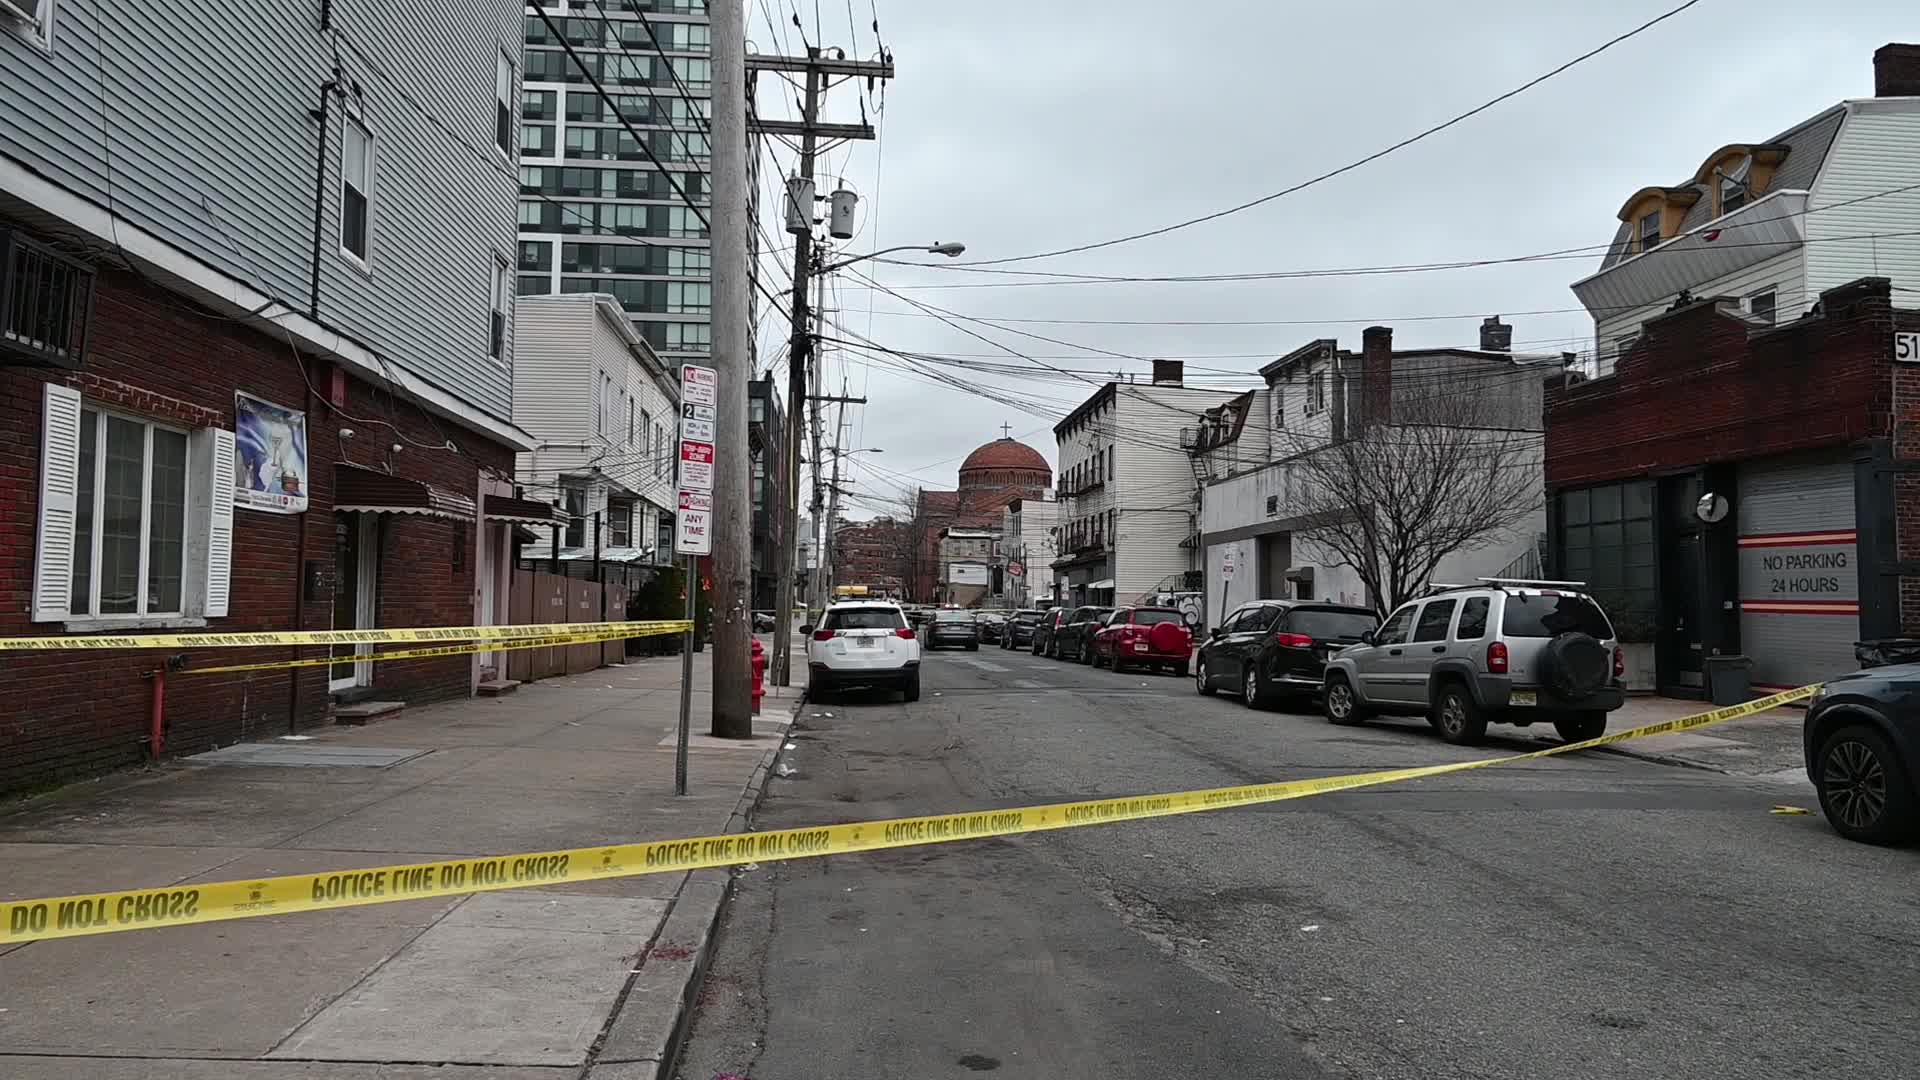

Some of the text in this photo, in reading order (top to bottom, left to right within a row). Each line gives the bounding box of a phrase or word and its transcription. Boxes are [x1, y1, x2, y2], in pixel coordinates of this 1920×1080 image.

[1897, 334, 1918, 359] 51
[685, 405, 693, 418] 2
[685, 514, 704, 524] ANY
[683, 525, 704, 536] TIME
[1764, 552, 1847, 570] NO PARKING
[1772, 577, 1839, 592] 24 HOURS
